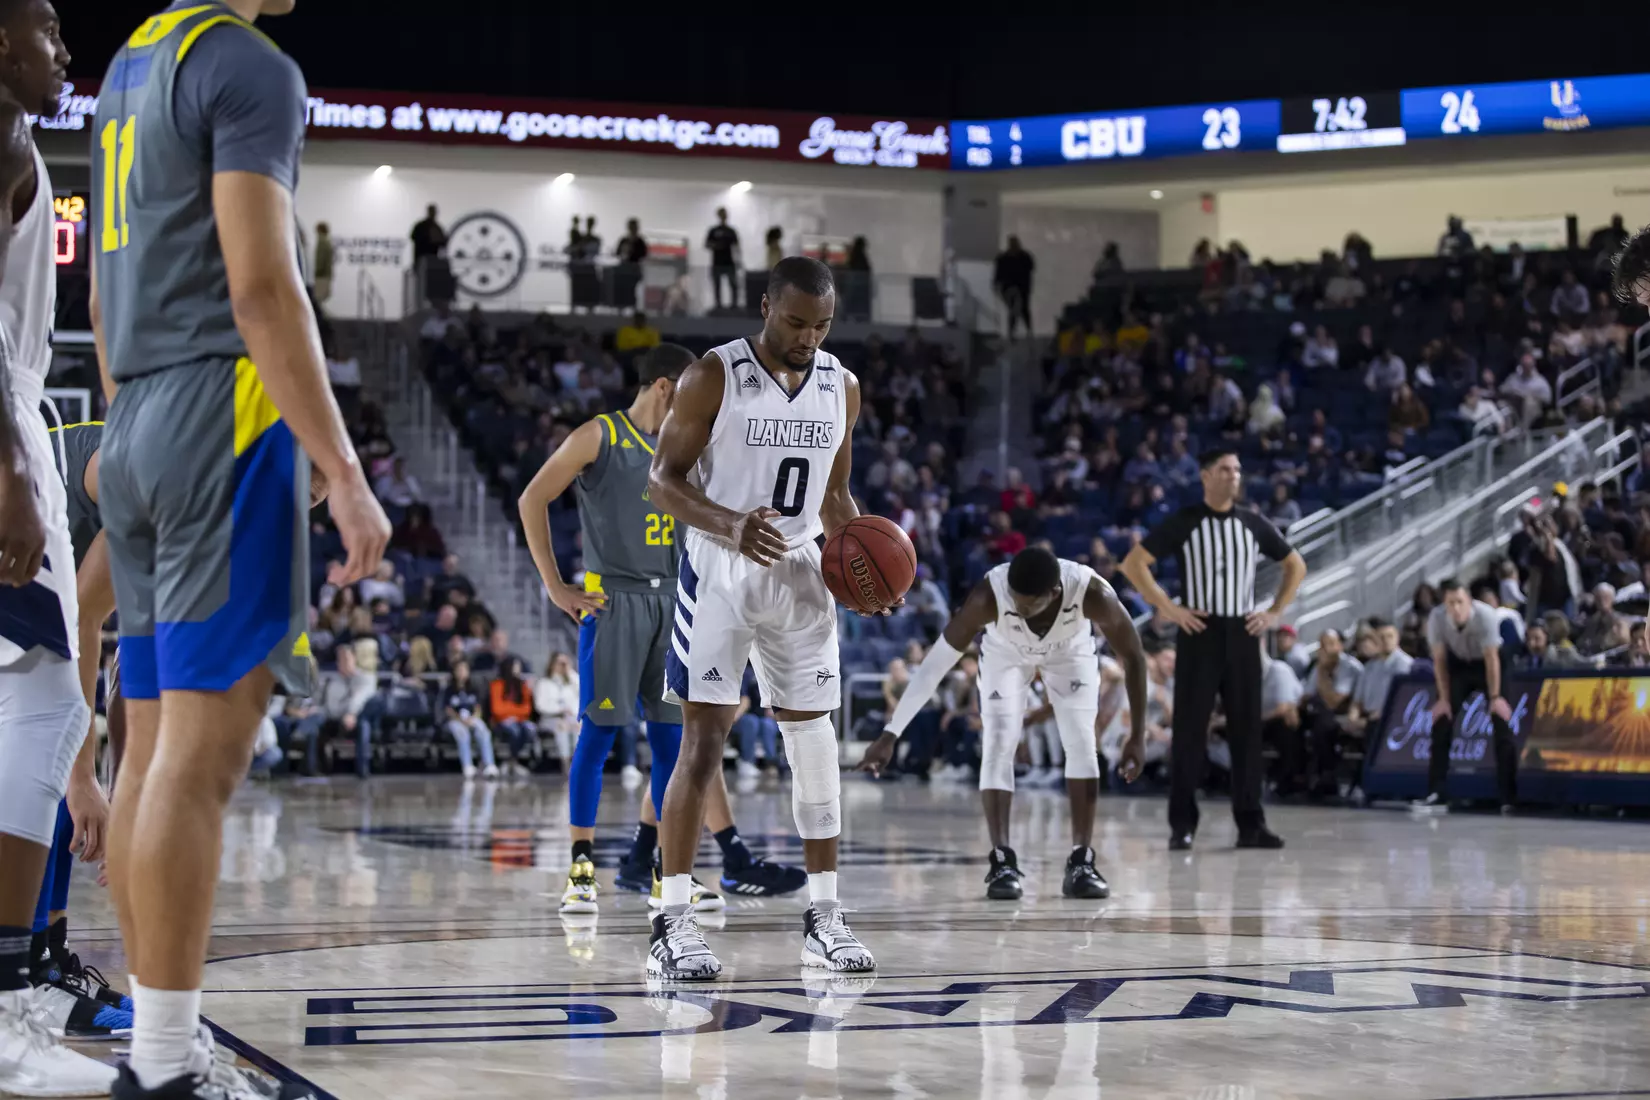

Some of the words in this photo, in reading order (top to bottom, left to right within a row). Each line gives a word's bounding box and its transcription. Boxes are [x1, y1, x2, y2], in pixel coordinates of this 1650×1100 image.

[305, 97, 386, 129] Times
[391, 102, 423, 130] at
[426, 107, 780, 150] www.goosecreekgc.com
[1202, 107, 1241, 150] 23
[1312, 96, 1368, 132] 7:42
[1440, 90, 1481, 134] 24
[1061, 116, 1146, 160] CBU
[101, 114, 136, 253] 11
[54, 196, 85, 222] 42
[817, 383, 835, 393] WAC
[746, 418, 833, 449] LANCERS
[772, 457, 809, 517] 0
[645, 513, 675, 546] 22
[701, 674, 723, 682] adidas
